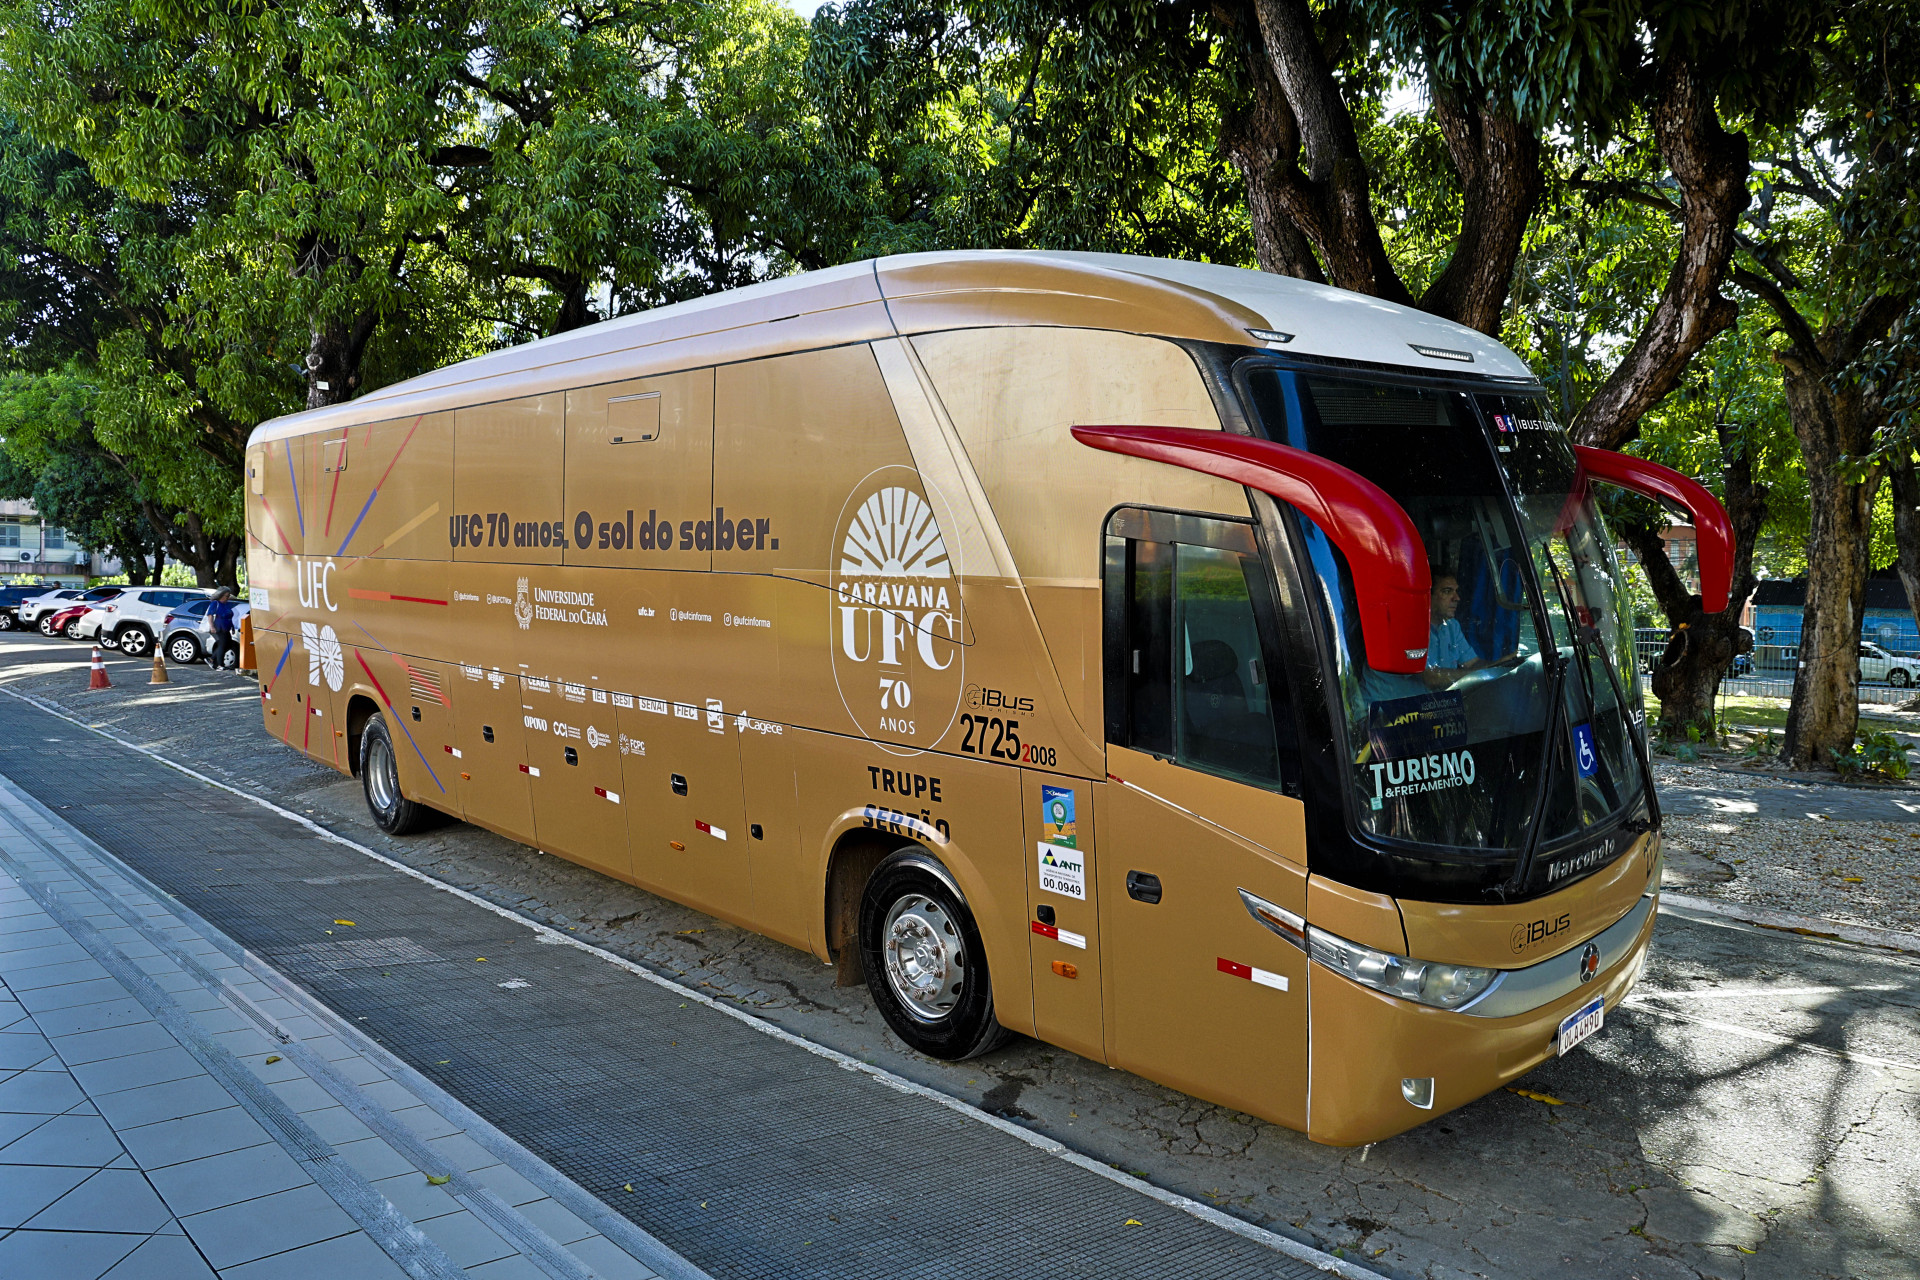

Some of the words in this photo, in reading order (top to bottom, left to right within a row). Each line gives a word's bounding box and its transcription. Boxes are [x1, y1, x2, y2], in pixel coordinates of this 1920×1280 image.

[450, 513, 483, 547] UFC
[487, 512, 510, 547] 70
[514, 521, 569, 549] anos.
[574, 511, 594, 549] O
[599, 510, 634, 550] sol
[639, 509, 674, 550] do
[679, 507, 780, 551] saber.
[297, 560, 338, 612] UFC
[838, 581, 950, 609] CARAVANA
[534, 587, 595, 607] UNIVERSIDADE
[535, 605, 569, 622] FEDERAL
[569, 612, 580, 623] DO
[580, 608, 609, 627] CEARÁ
[638, 606, 656, 617] ufc.br
[678, 610, 712, 622] @ufcinforma
[733, 615, 771, 628] @ufcinforma
[838, 606, 954, 671] UFC
[487, 673, 505, 684] SEBRAE
[527, 675, 551, 689] CEARÁ
[594, 690, 605, 701] IEL
[613, 693, 631, 705] SESI
[878, 676, 911, 710] 70
[640, 699, 666, 713] SENAI
[676, 705, 696, 718] FIEC
[981, 706, 1035, 718] TURISMO
[747, 718, 783, 735] Cagece
[879, 716, 916, 735] ANOS
[1393, 711, 1420, 727] ANTT
[630, 739, 646, 751] FCPC
[960, 713, 1021, 761] 2725
[1022, 743, 1057, 767] 2008
[867, 765, 942, 803] TRUPE
[1369, 750, 1475, 799] TURISMO
[862, 803, 951, 845] SERTÃO
[1059, 860, 1082, 873] ANTT
[1547, 838, 1616, 882] Marcopolo
[1043, 877, 1081, 896] 00.0949
